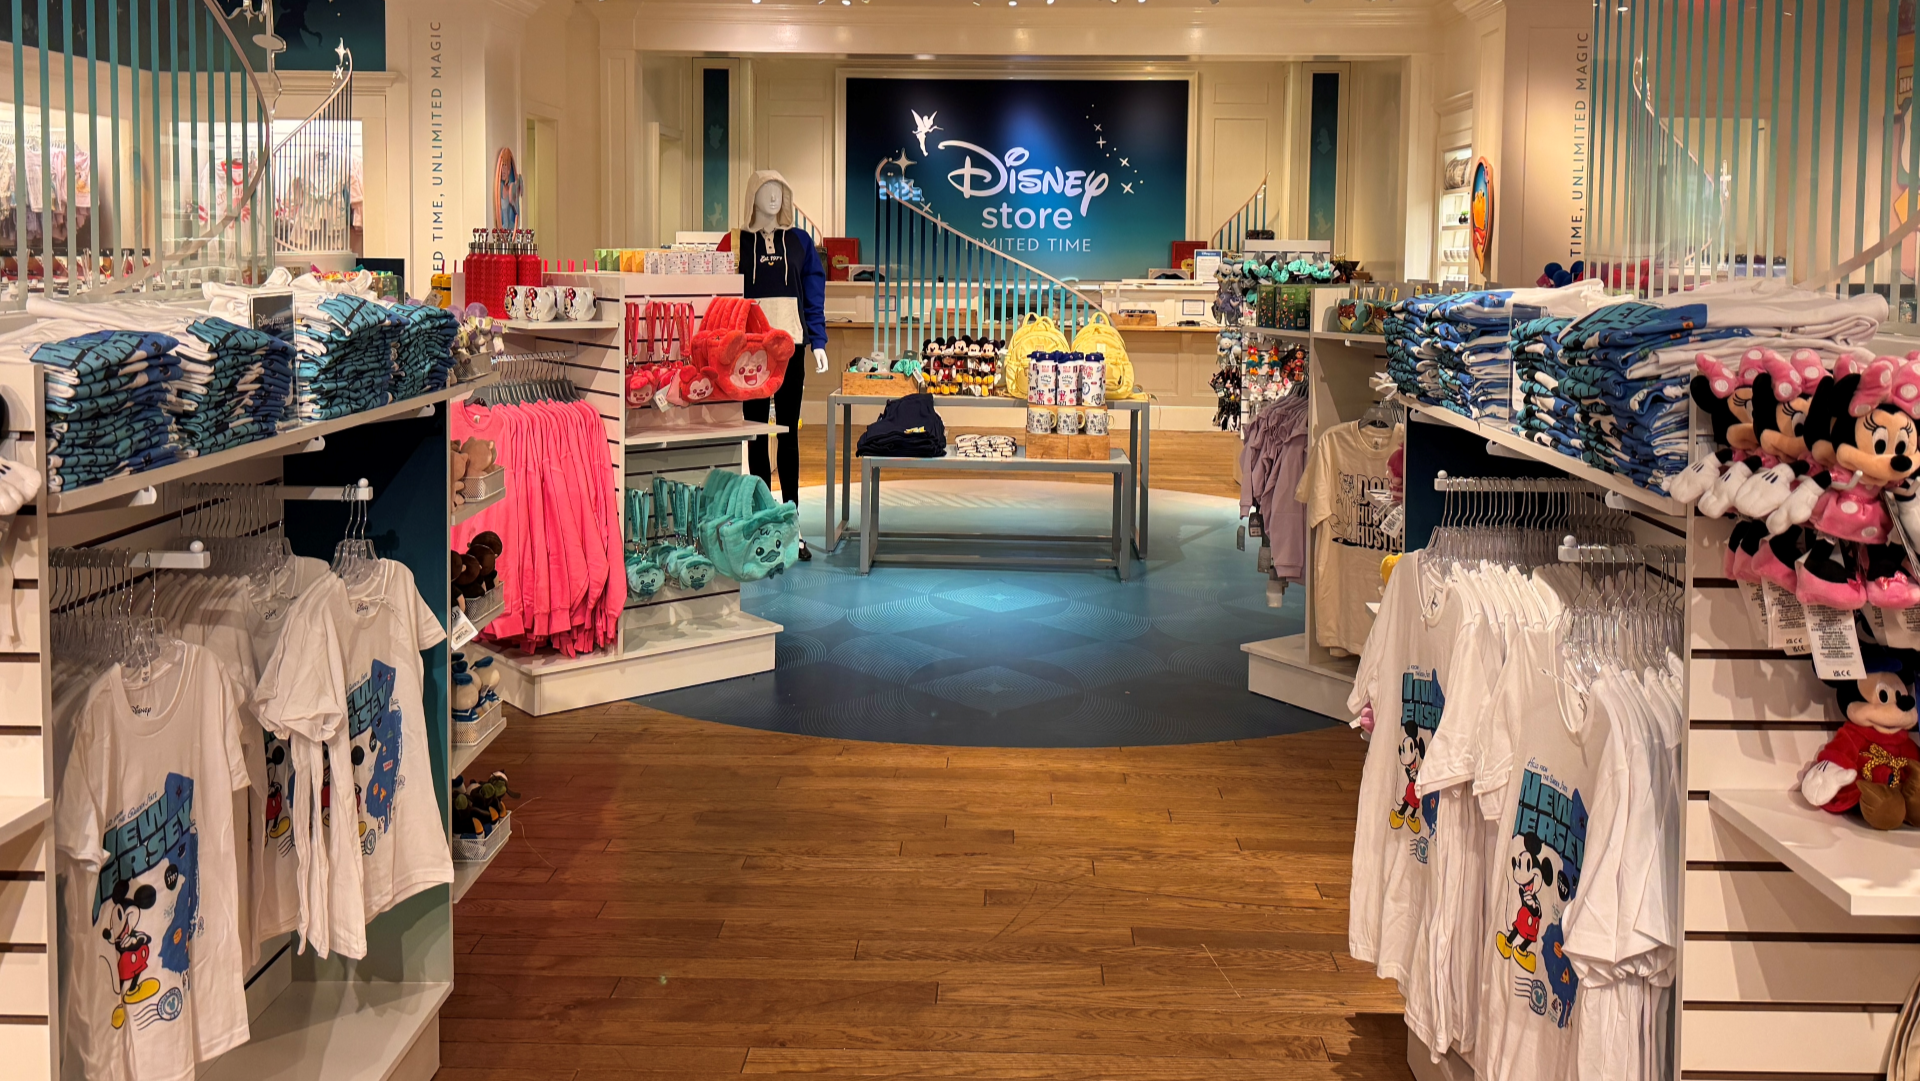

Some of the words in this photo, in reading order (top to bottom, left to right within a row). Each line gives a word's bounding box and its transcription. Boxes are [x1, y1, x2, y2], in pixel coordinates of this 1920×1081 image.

[430, 22, 441, 79] MAGIC
[1576, 33, 1589, 91] MAGIC
[431, 88, 443, 186] UNLIMITED
[1572, 100, 1586, 200] UNLIMITED
[937, 139, 1110, 218] Disney
[432, 193, 445, 242] TIME,
[981, 202, 1073, 230] store
[1570, 208, 1585, 258] TIME,
[1047, 238, 1092, 252] TIME
[1519, 768, 1574, 828] NEW
